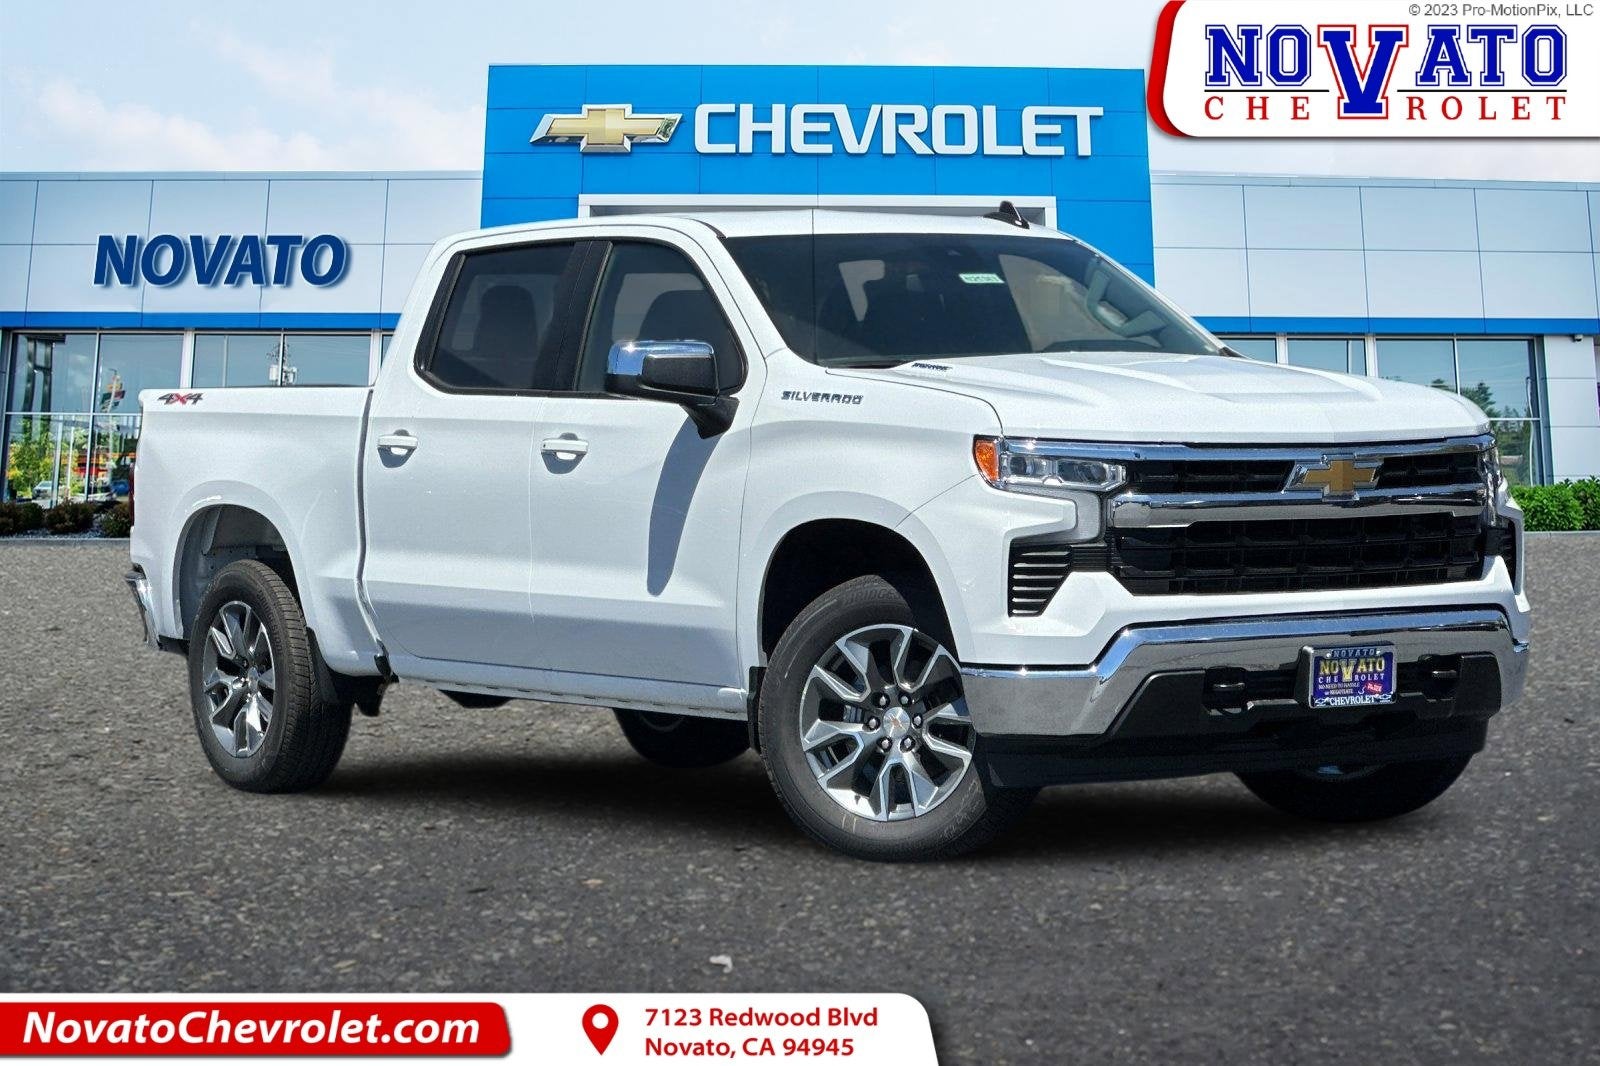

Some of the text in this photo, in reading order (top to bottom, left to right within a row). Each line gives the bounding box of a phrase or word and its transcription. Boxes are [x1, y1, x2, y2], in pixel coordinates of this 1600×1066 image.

[694, 103, 1104, 157] CHEVROLET
[93, 233, 348, 288] NOVATO
[781, 390, 864, 405] SILVERADO
[1333, 648, 1375, 657] NOVATO
[1320, 658, 1385, 682] NOVATO
[1329, 694, 1375, 706] CHEVROLET
